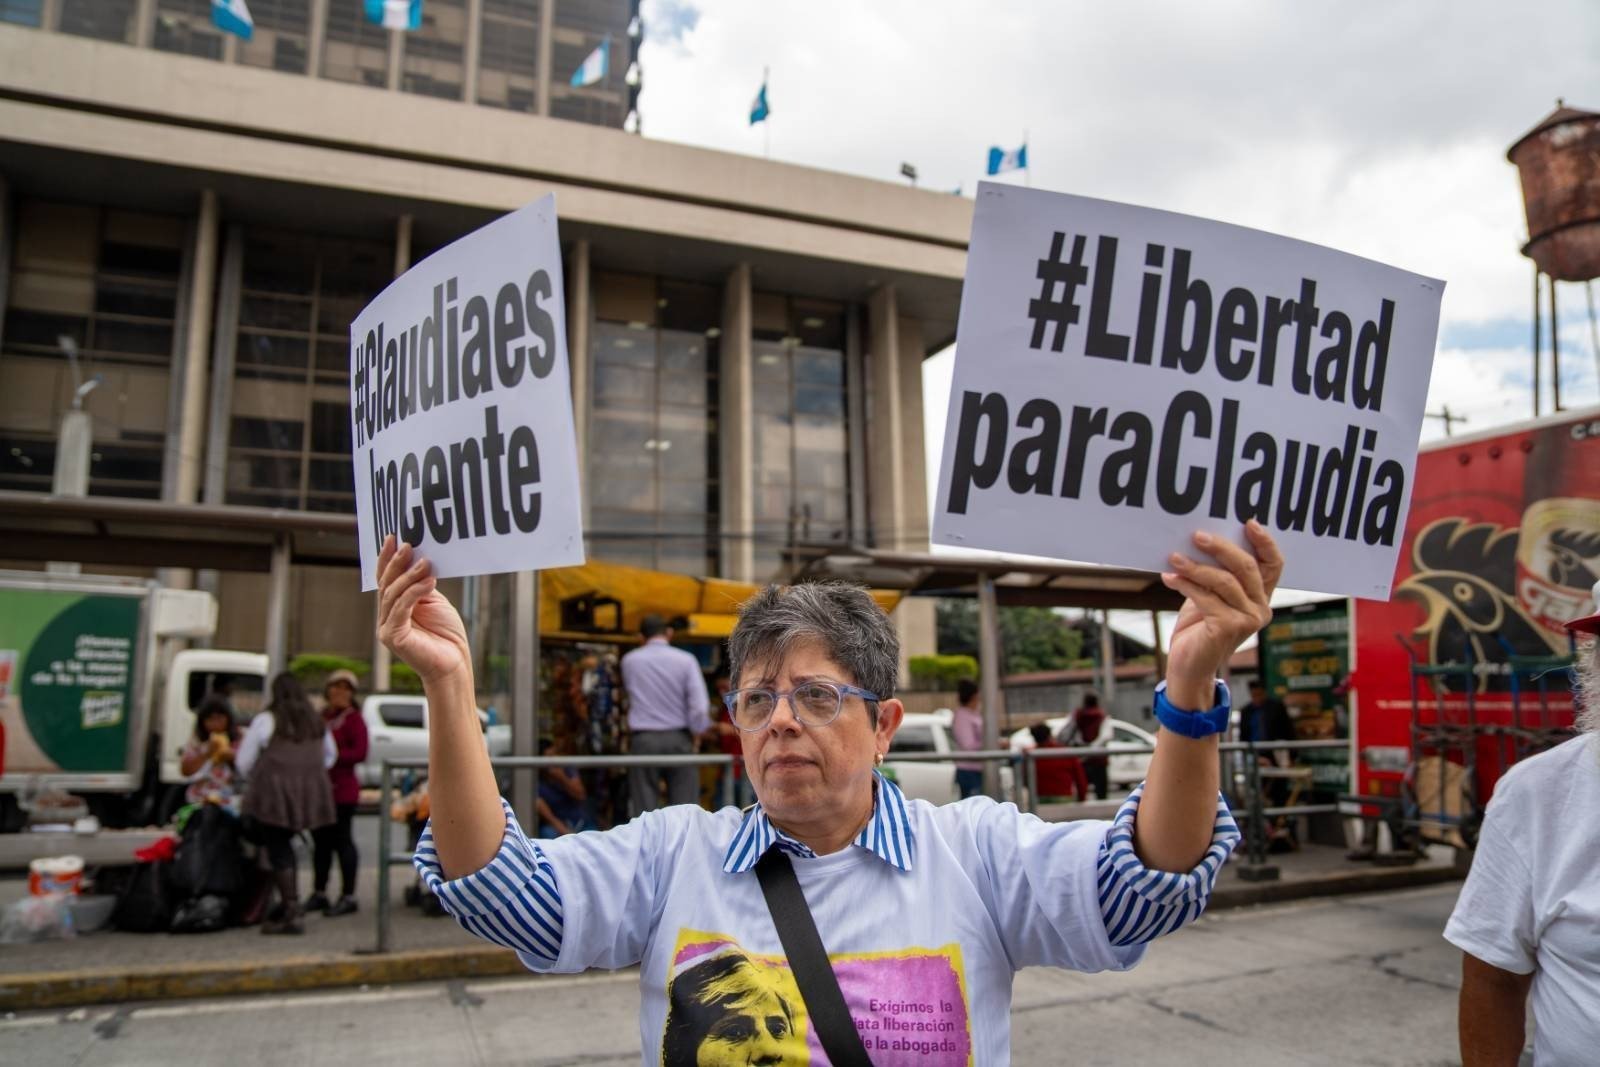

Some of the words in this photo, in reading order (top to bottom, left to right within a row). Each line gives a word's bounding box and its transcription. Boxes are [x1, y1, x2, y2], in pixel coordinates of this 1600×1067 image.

[354, 268, 557, 448] #Claudiaes
[1027, 231, 1395, 412] #Libertad
[369, 404, 542, 557] Inocente
[946, 389, 1405, 547] paraClaudia
[853, 1017, 880, 1031] iata
[883, 1017, 955, 1032] liberación
[869, 999, 934, 1016] Exigimos
[940, 999, 953, 1013] la
[876, 1036, 888, 1050] la
[892, 1037, 957, 1055] abogada
